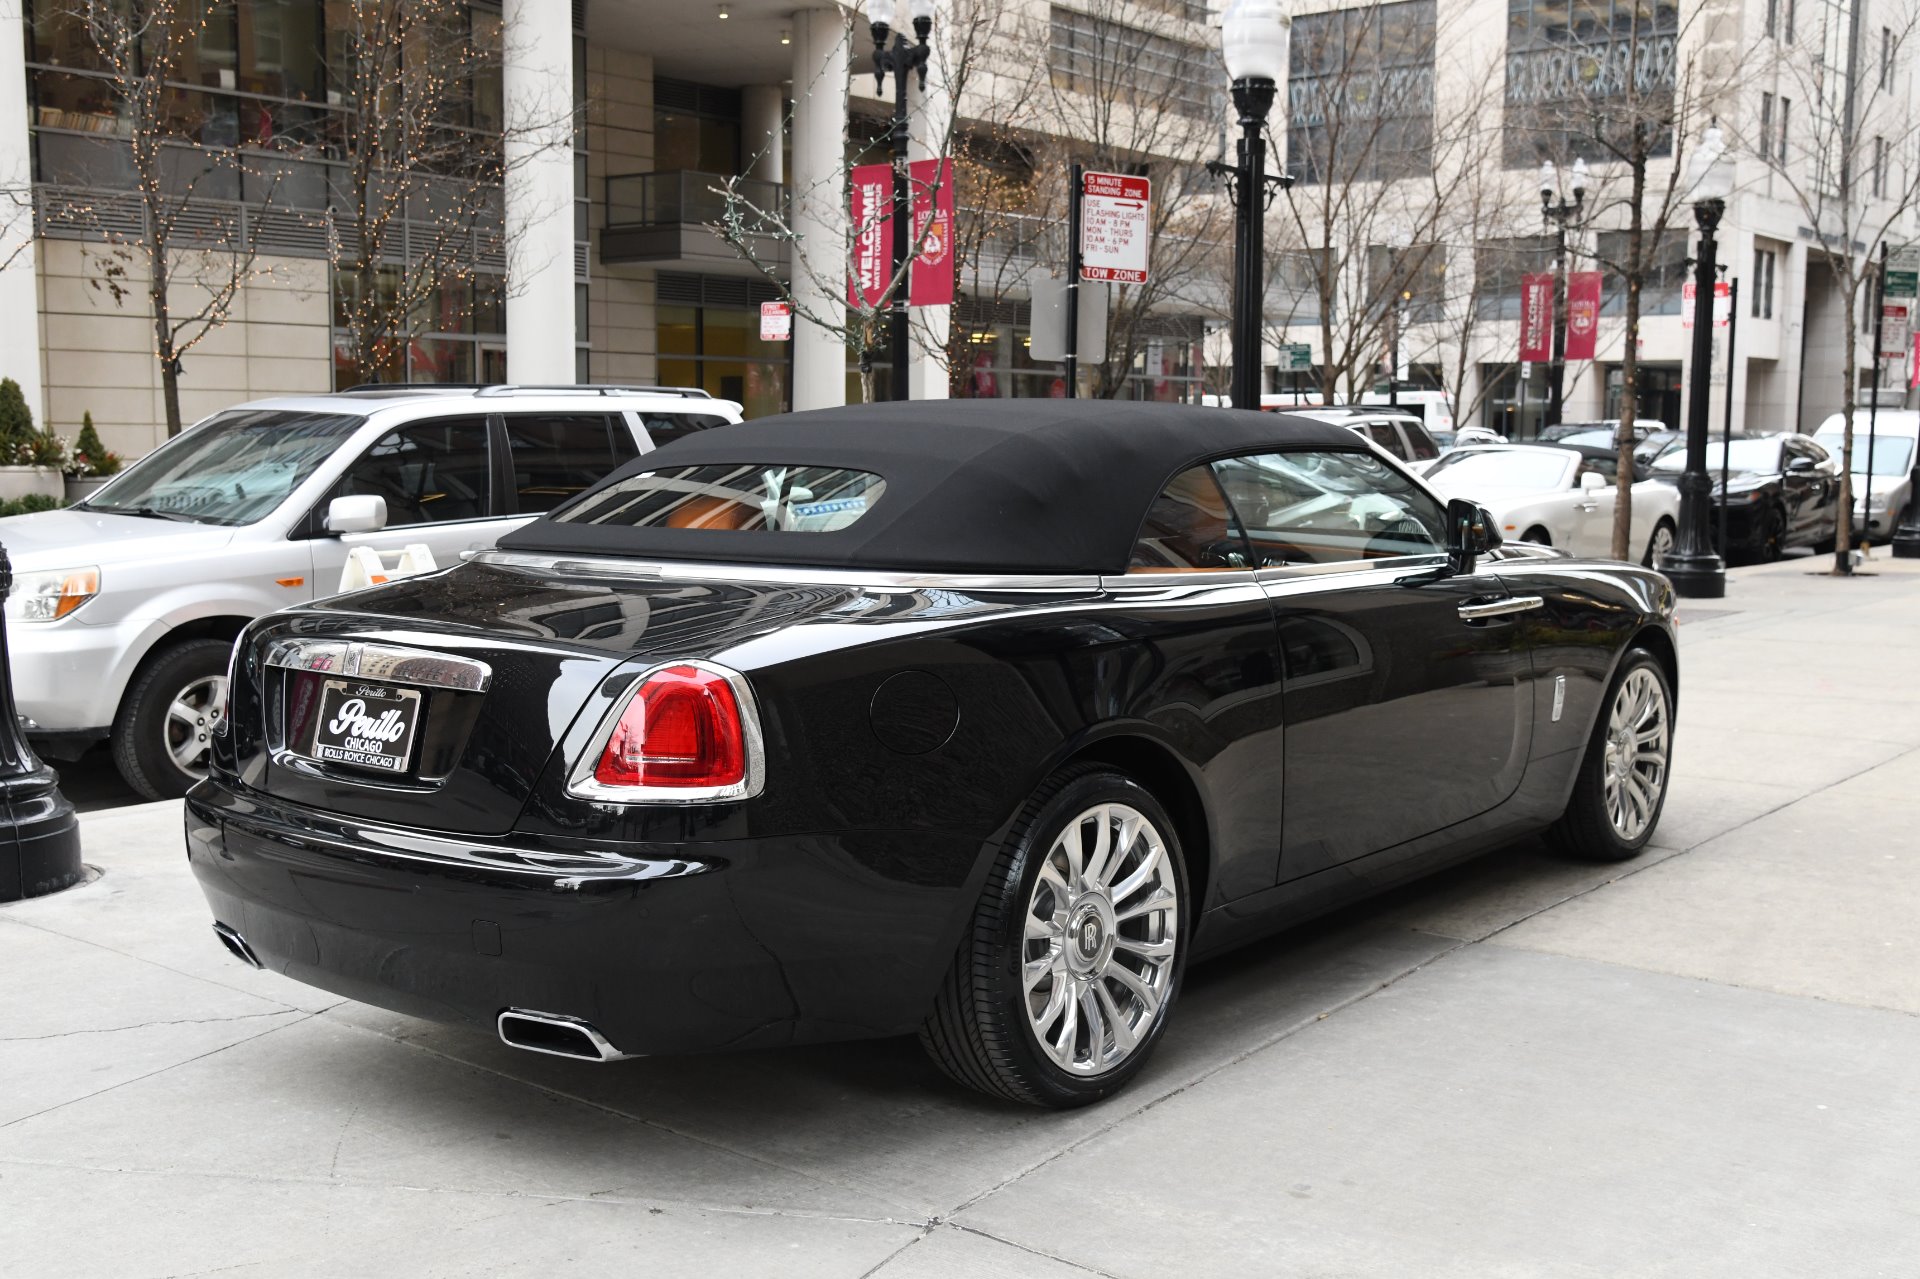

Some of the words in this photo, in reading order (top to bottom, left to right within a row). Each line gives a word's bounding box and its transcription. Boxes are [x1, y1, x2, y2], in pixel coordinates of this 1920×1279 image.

[1088, 176, 1096, 184] 15
[1096, 177, 1122, 187] MINUTE
[1088, 185, 1121, 197] STANDING
[1124, 188, 1143, 198] ZONE
[1087, 199, 1101, 208] USE
[1087, 209, 1120, 219] FLASHING
[1122, 212, 1145, 222] LIGHTS
[1120, 220, 1130, 228] PM
[860, 184, 875, 290] WELCOME
[1086, 226, 1102, 234] MON
[1110, 228, 1133, 237] THURS
[874, 223, 882, 257] TOWER
[1119, 238, 1129, 246] PM
[1086, 244, 1098, 252] FRI
[1104, 245, 1119, 254] SUN
[1086, 267, 1108, 279] TOW
[1113, 270, 1141, 282] ZONE
[356, 685, 387, 698] Perillo
[329, 699, 405, 743] Perillo
[344, 737, 383, 753] CHICAGO
[324, 748, 343, 759] ROLLS
[344, 751, 365, 763] ROYCE
[365, 754, 393, 767] CHICAGO
